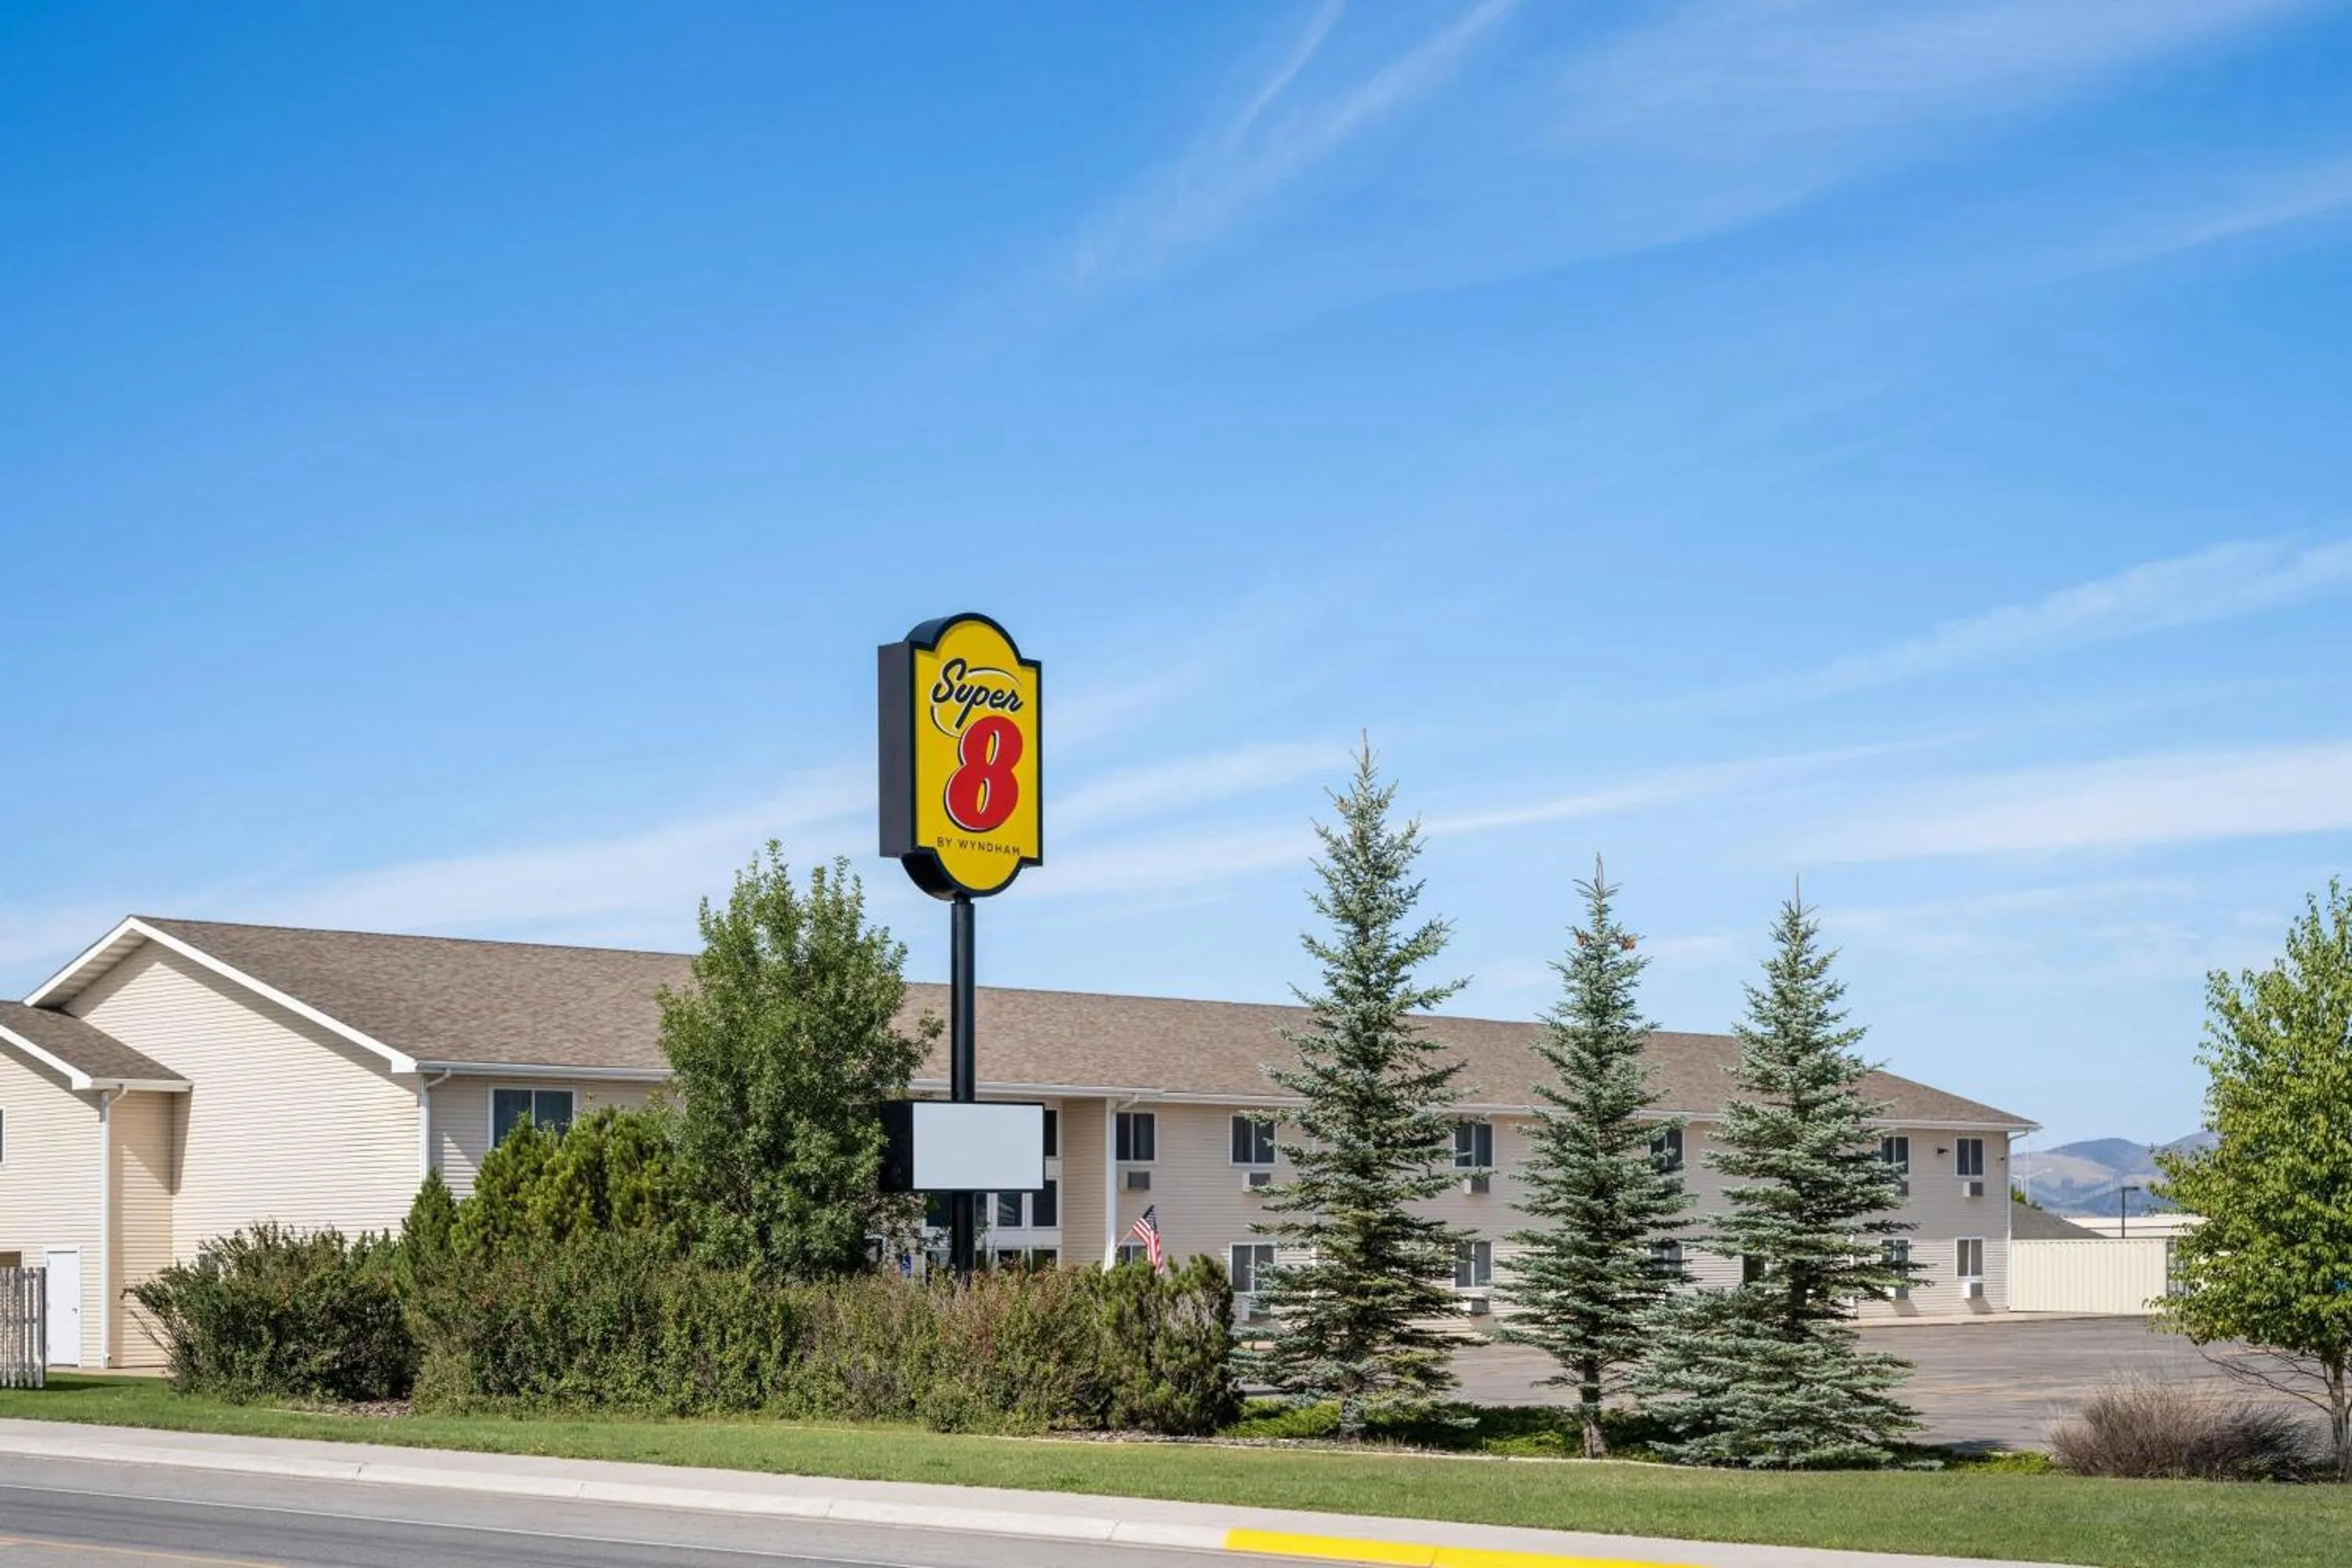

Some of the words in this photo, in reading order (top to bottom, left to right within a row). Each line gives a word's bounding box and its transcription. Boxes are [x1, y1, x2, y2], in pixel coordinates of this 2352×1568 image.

[931, 658, 1023, 729] Super
[944, 715, 1023, 833] 8
[937, 836, 952, 848] BY
[957, 839, 1020, 856] WYNDHAM
